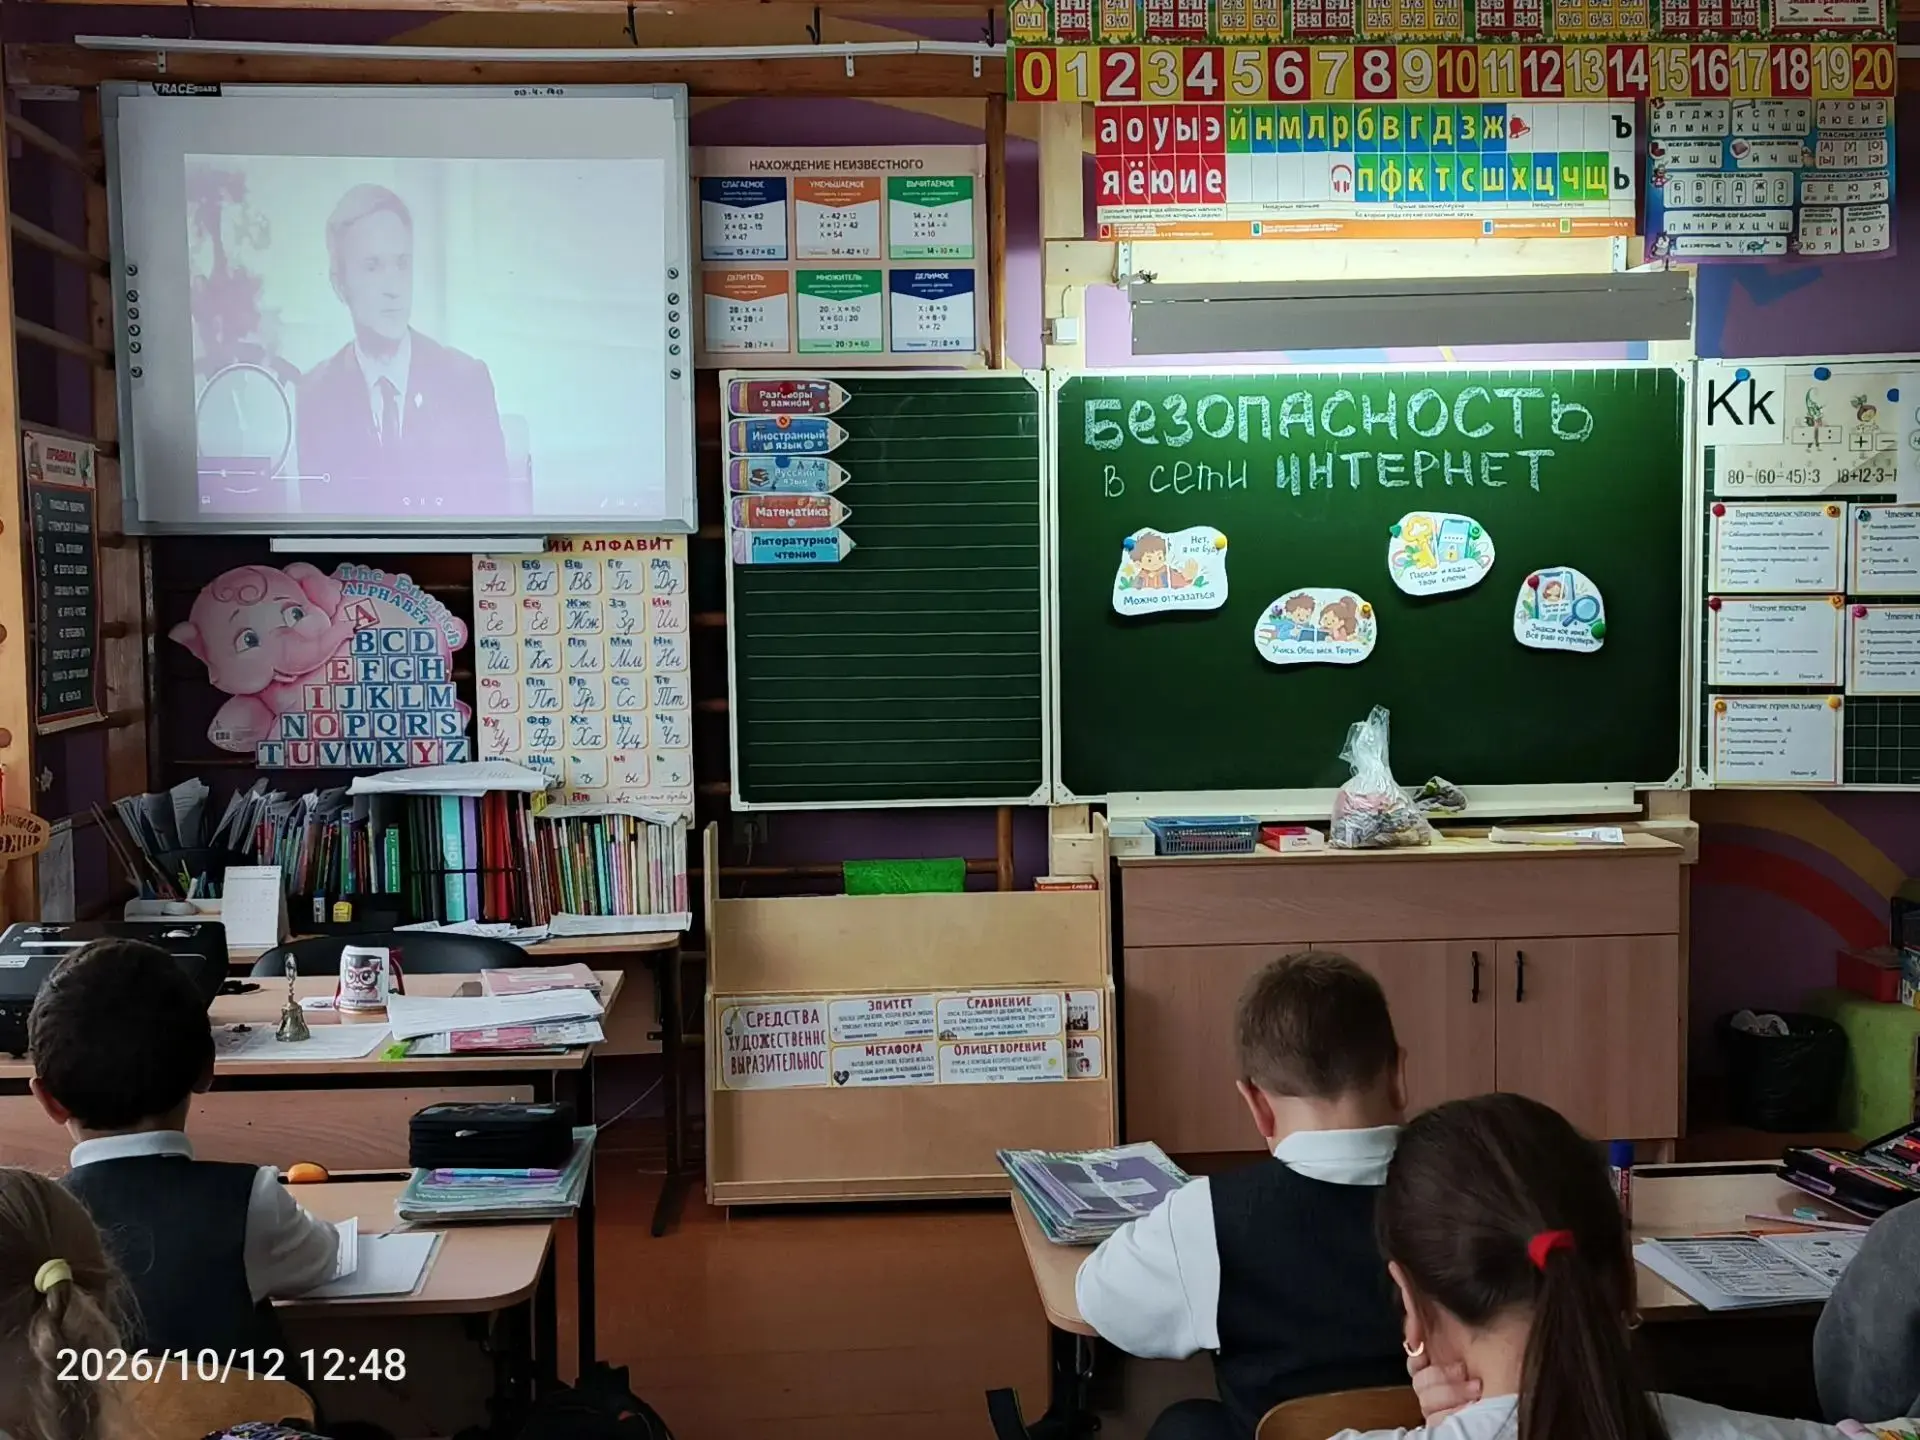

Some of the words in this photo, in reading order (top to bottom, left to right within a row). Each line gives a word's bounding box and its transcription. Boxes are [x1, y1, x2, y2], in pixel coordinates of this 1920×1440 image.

[1022, 52, 1051, 96] 0
[1065, 52, 1087, 97] 1
[1106, 52, 1135, 96] 2
[1148, 51, 1179, 96] 3
[1186, 52, 1217, 96] 4
[1232, 51, 1262, 96] 5
[1275, 50, 1304, 95] 6
[1318, 51, 1348, 95] 7
[1362, 49, 1391, 94] 8
[1402, 49, 1432, 94] 9
[1439, 49, 1476, 93] 10
[1483, 48, 1516, 93] 11
[1523, 49, 1562, 92] 12
[1566, 48, 1605, 93] 13
[1609, 48, 1648, 92] 14
[1651, 48, 1689, 91] 15
[1691, 48, 1729, 91] 16
[1731, 47, 1769, 91] 17
[1772, 47, 1810, 90] 18
[1813, 46, 1850, 90] 19
[1854, 47, 1893, 90] 20
[749, 160, 831, 171] НАХОЖДЕНИЕ
[833, 159, 924, 170] НЕИЗВЕСТНОГО
[721, 181, 765, 189] СЛАГАЕМОЕ
[809, 180, 864, 189] УМЕНЬШАЕМОЕ
[906, 180, 954, 188] ВЫЧИТАЕМОЕ
[816, 273, 862, 282] МНОЖИТЕЛЬ
[915, 272, 949, 281] ДЕЛИМОЕ
[752, 430, 825, 441] Иностранный
[775, 442, 803, 450] язык
[1150, 460, 1248, 494] сети
[1276, 449, 1555, 497] ИНТЕРНЕТ
[756, 507, 828, 517] Математика
[583, 537, 674, 552] АЛФАВИТ
[752, 536, 838, 549] Литературное
[774, 550, 817, 559] чтение
[340, 565, 384, 582] The
[343, 583, 430, 625] ALPHABET
[1123, 595, 1158, 605] Можно
[356, 605, 376, 627] A
[356, 633, 375, 651] B
[382, 632, 403, 651] C
[413, 632, 434, 651] D
[331, 660, 350, 680] E
[361, 660, 380, 680] F
[390, 660, 411, 680] G
[420, 659, 441, 679] H
[312, 688, 324, 708] I
[340, 688, 355, 708] J
[368, 688, 390, 707] K
[401, 687, 421, 707] L
[430, 687, 453, 706] M
[284, 716, 306, 737] N
[314, 715, 336, 736] O
[346, 716, 366, 736] P
[377, 715, 397, 738] Q
[407, 715, 429, 735] R
[440, 714, 457, 734] S
[260, 744, 282, 764] T
[291, 744, 313, 764] U
[322, 744, 343, 764] V
[351, 743, 375, 763] W
[381, 743, 405, 763] X
[414, 742, 436, 763] Y
[446, 742, 466, 762] Z
[24, 926, 70, 934] acer
[868, 999, 913, 1011] ЭПИТЕТ
